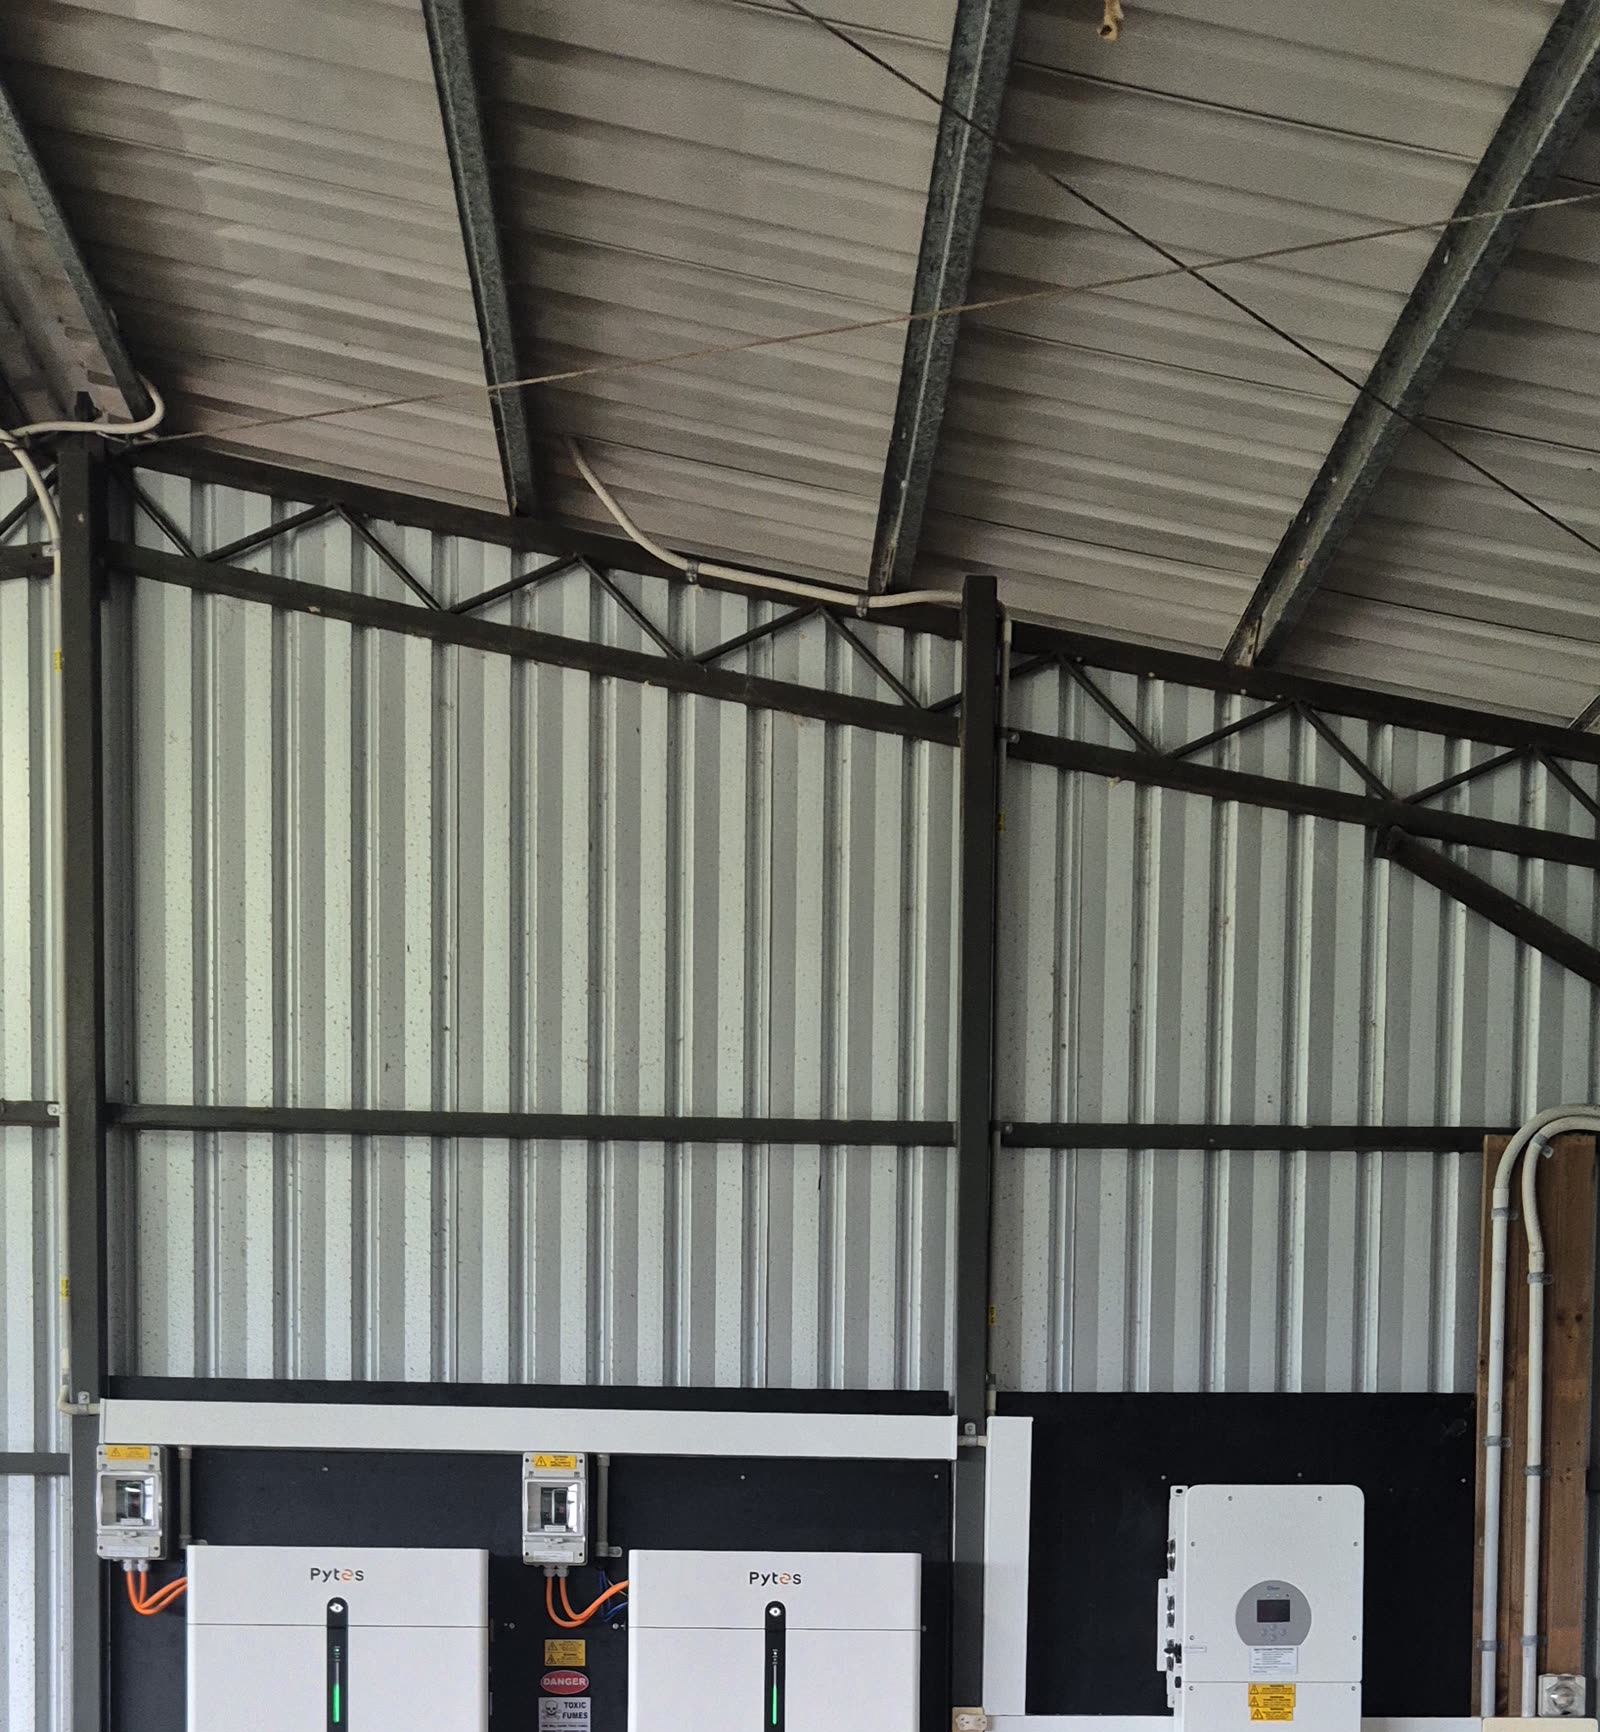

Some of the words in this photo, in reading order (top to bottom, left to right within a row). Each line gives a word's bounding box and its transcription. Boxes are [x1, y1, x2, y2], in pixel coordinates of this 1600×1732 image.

[310, 1567, 364, 1583] Pytes
[749, 1571, 802, 1586] Pytes
[543, 1677, 586, 1686] DANGER
[564, 1701, 587, 1709] TOXIC
[562, 1711, 588, 1720] FUMES
